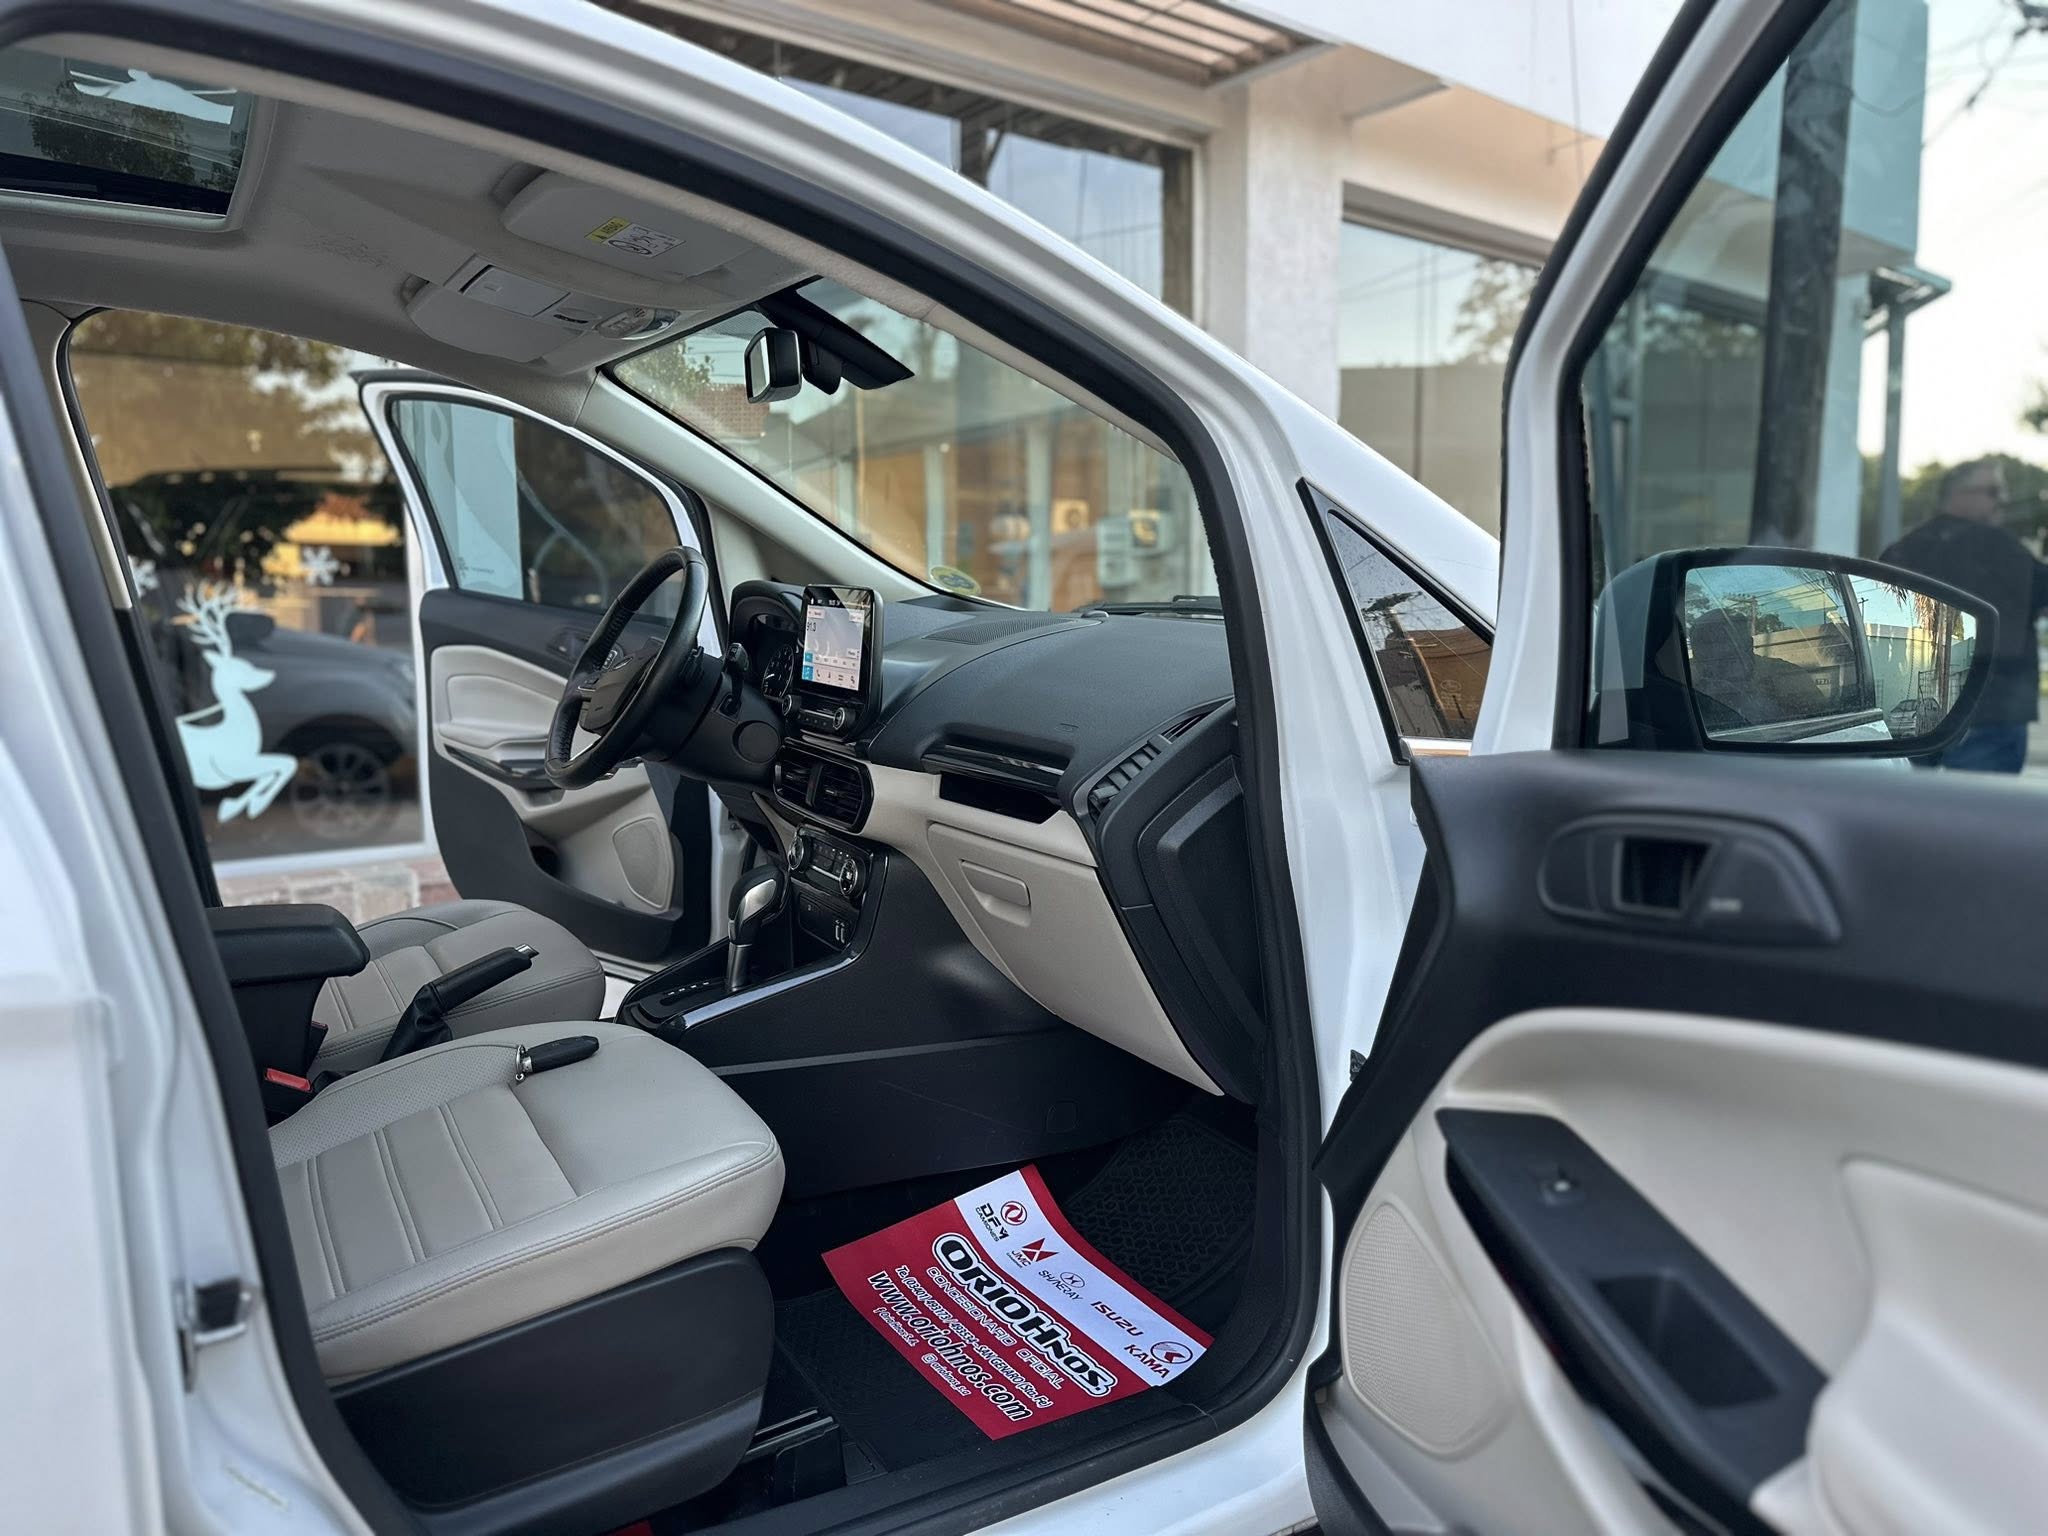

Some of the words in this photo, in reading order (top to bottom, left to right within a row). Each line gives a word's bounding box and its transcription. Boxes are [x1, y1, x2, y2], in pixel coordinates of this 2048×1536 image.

[1011, 1250, 1032, 1267] JMC
[926, 1266, 1018, 1347] CONCESIONARIO
[1016, 1348, 1064, 1389] OFICIAL
[1090, 1301, 1144, 1337] ISUZU
[867, 1270, 1033, 1421] www.oriohnos.com
[1124, 1343, 1170, 1378] KAMA
[973, 1345, 999, 1360] SAN
[989, 1357, 1026, 1384] GENARO
